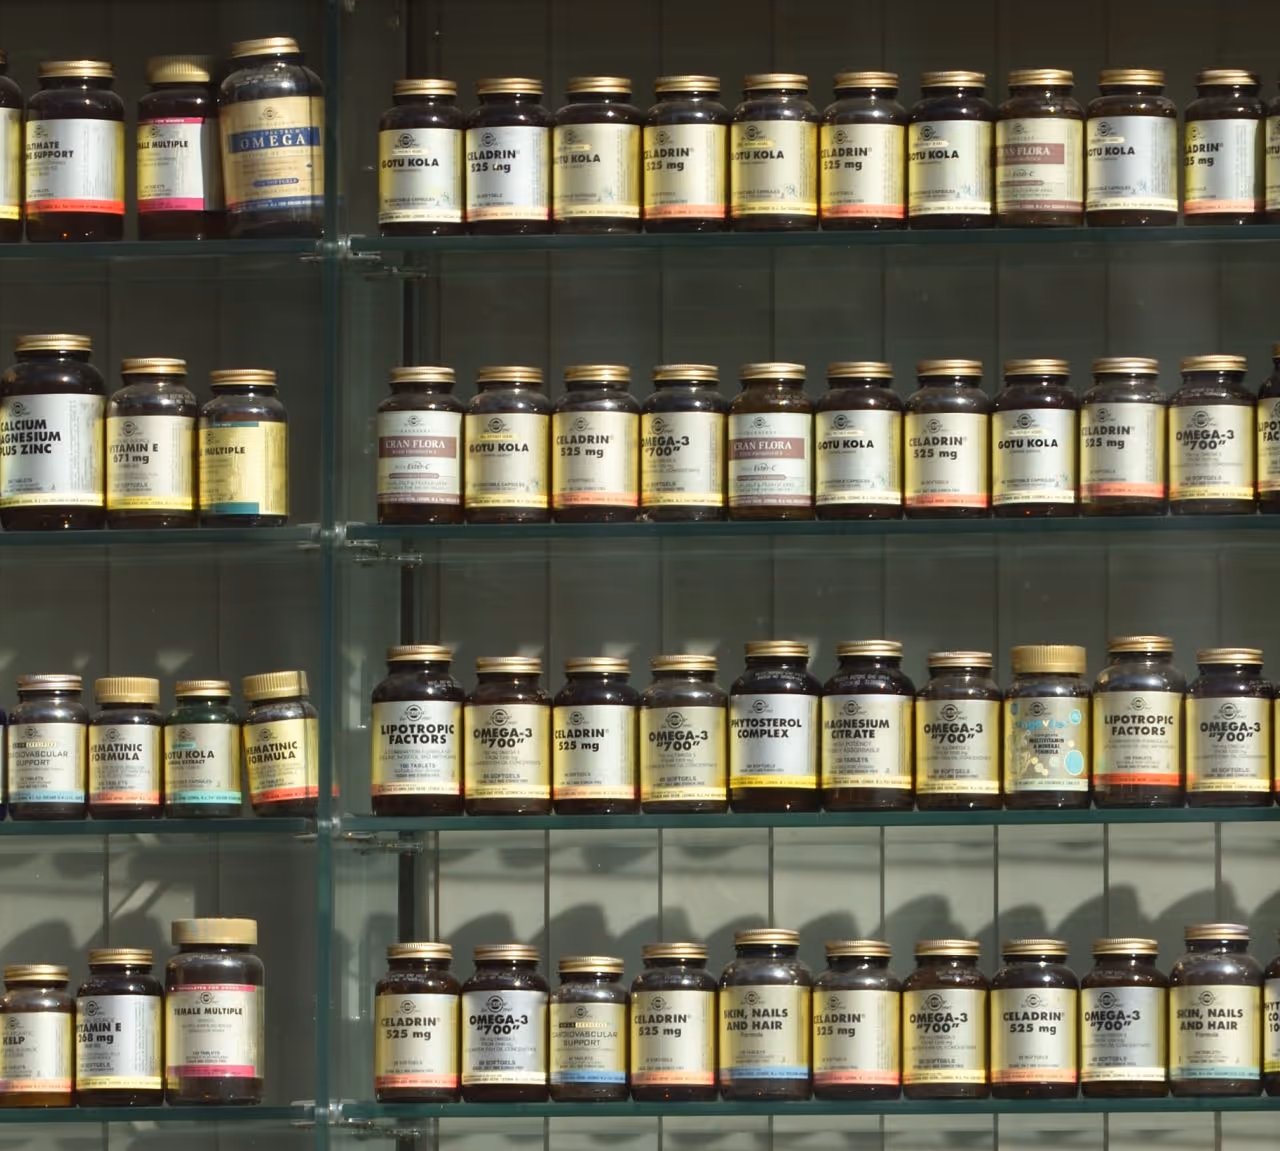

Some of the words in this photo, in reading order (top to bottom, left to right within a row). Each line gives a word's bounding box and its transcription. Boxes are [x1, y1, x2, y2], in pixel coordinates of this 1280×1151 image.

[754, 150, 785, 160] KOLA
[929, 149, 959, 159] KOLA
[1105, 147, 1135, 157] KOLA
[408, 157, 440, 167] KOLA
[666, 161, 685, 172] mg
[21, 443, 53, 455] ZINC
[412, 439, 445, 449] FLORA
[498, 442, 530, 452] KOLA
[759, 439, 792, 450] FLORA
[843, 439, 875, 449] KOLA
[998, 440, 1024, 451] GOTU
[585, 448, 604, 459] mg
[913, 449, 935, 459] 525
[938, 450, 958, 461] mg
[1104, 714, 1174, 725] LIPOTROPIC
[381, 723, 455, 735] LIPOTROPIC
[924, 723, 984, 734] OMEGA-3
[1111, 726, 1166, 736] FACTORS
[1199, 721, 1261, 732] OMEGA-3
[472, 727, 533, 738] OMEGA-3
[649, 731, 709, 742] OMEGA-3
[737, 729, 790, 739] COMPLEX
[389, 734, 448, 745] FACTORS
[558, 741, 578, 751] 525
[581, 743, 600, 753] mg
[204, 1008, 243, 1016] MULTIPLE
[752, 1008, 789, 1018] NAILS
[1208, 1009, 1243, 1019] NAILS
[469, 1014, 528, 1026] OMEGA-3
[639, 1026, 659, 1036] 525
[727, 1021, 748, 1031] AND
[752, 1021, 782, 1030] HAIR
[386, 1029, 408, 1039] 525
[412, 1030, 432, 1041] mg
